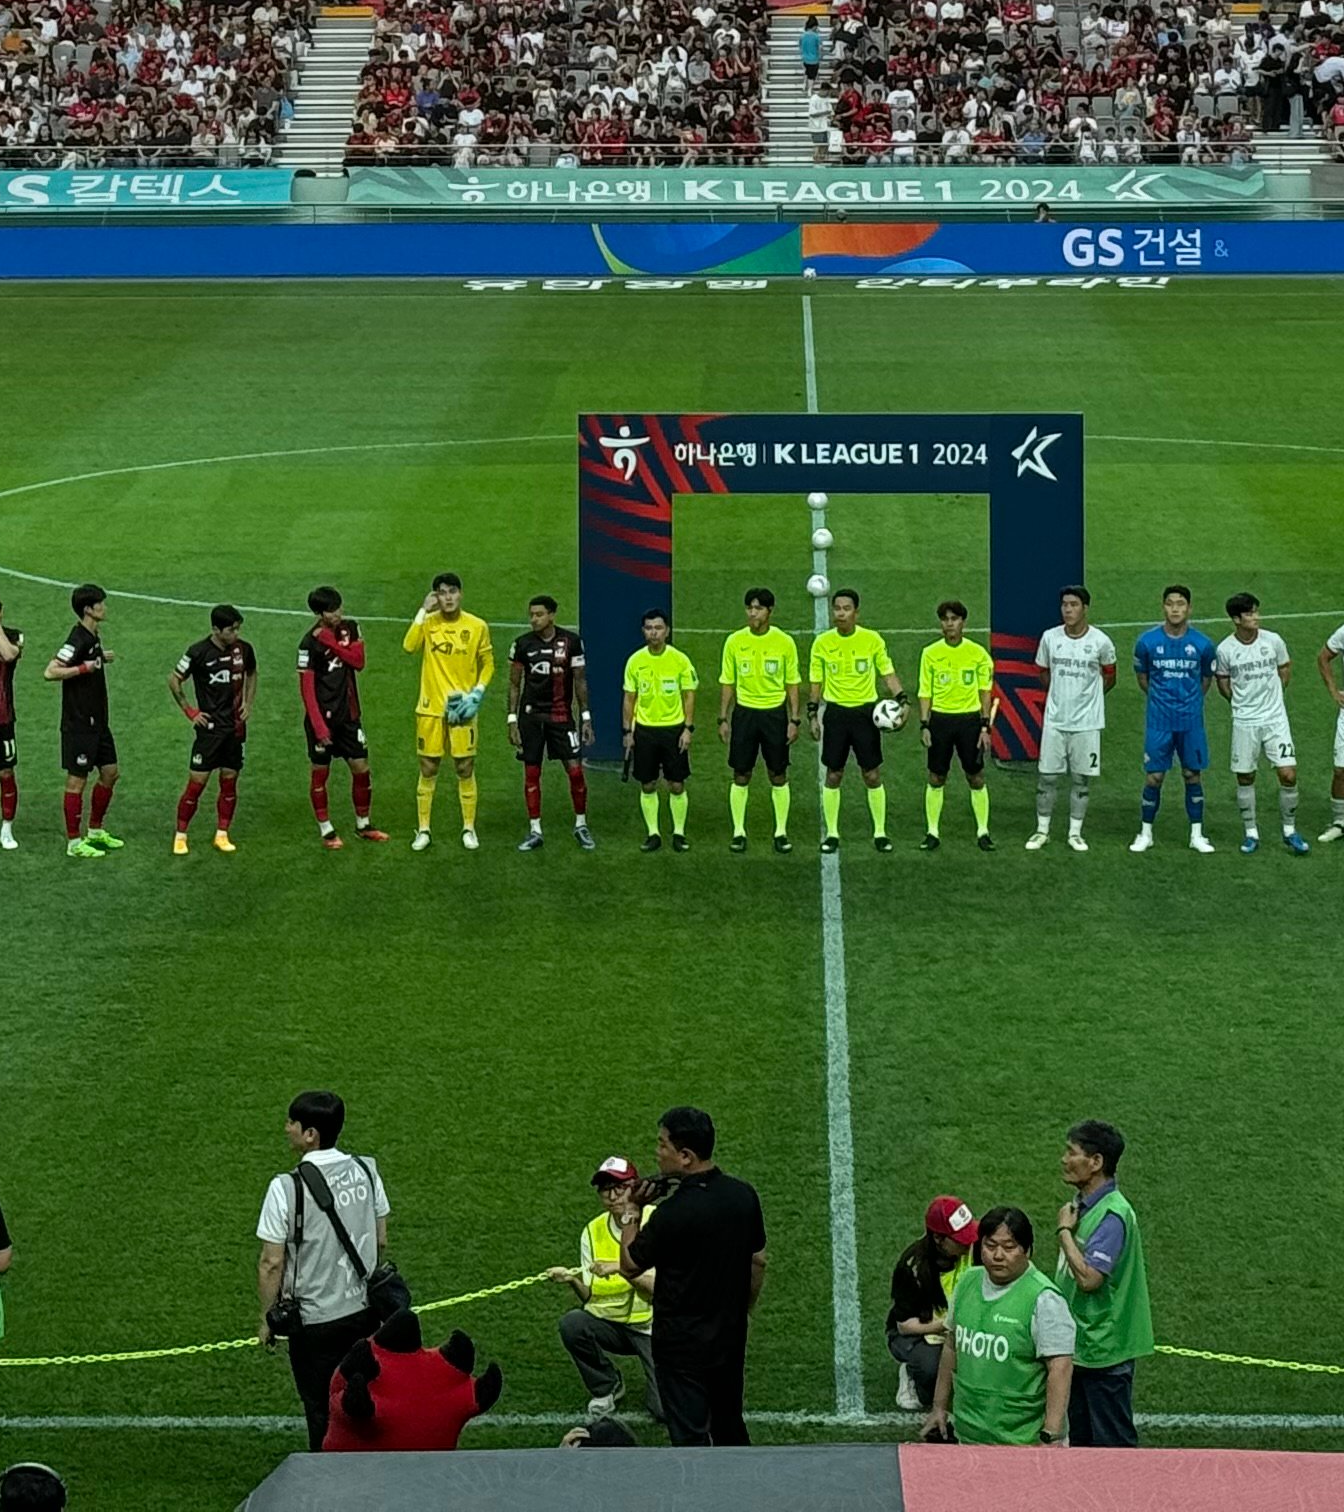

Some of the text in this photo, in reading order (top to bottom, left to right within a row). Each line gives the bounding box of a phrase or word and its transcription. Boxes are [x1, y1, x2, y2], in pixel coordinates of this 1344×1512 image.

[67, 172, 242, 207] 칼텍스
[506, 179, 651, 202] 하나은행
[684, 179, 721, 201] K
[732, 179, 924, 202] LEAGUE
[979, 178, 1083, 201] 2024
[1062, 227, 1125, 267] GS
[1133, 227, 1203, 267] 건설
[674, 441, 989, 467] 하나은행 K LEAGUE 1 2024
[1089, 752, 1098, 769] 2
[955, 1324, 1009, 1362] PHOTO
